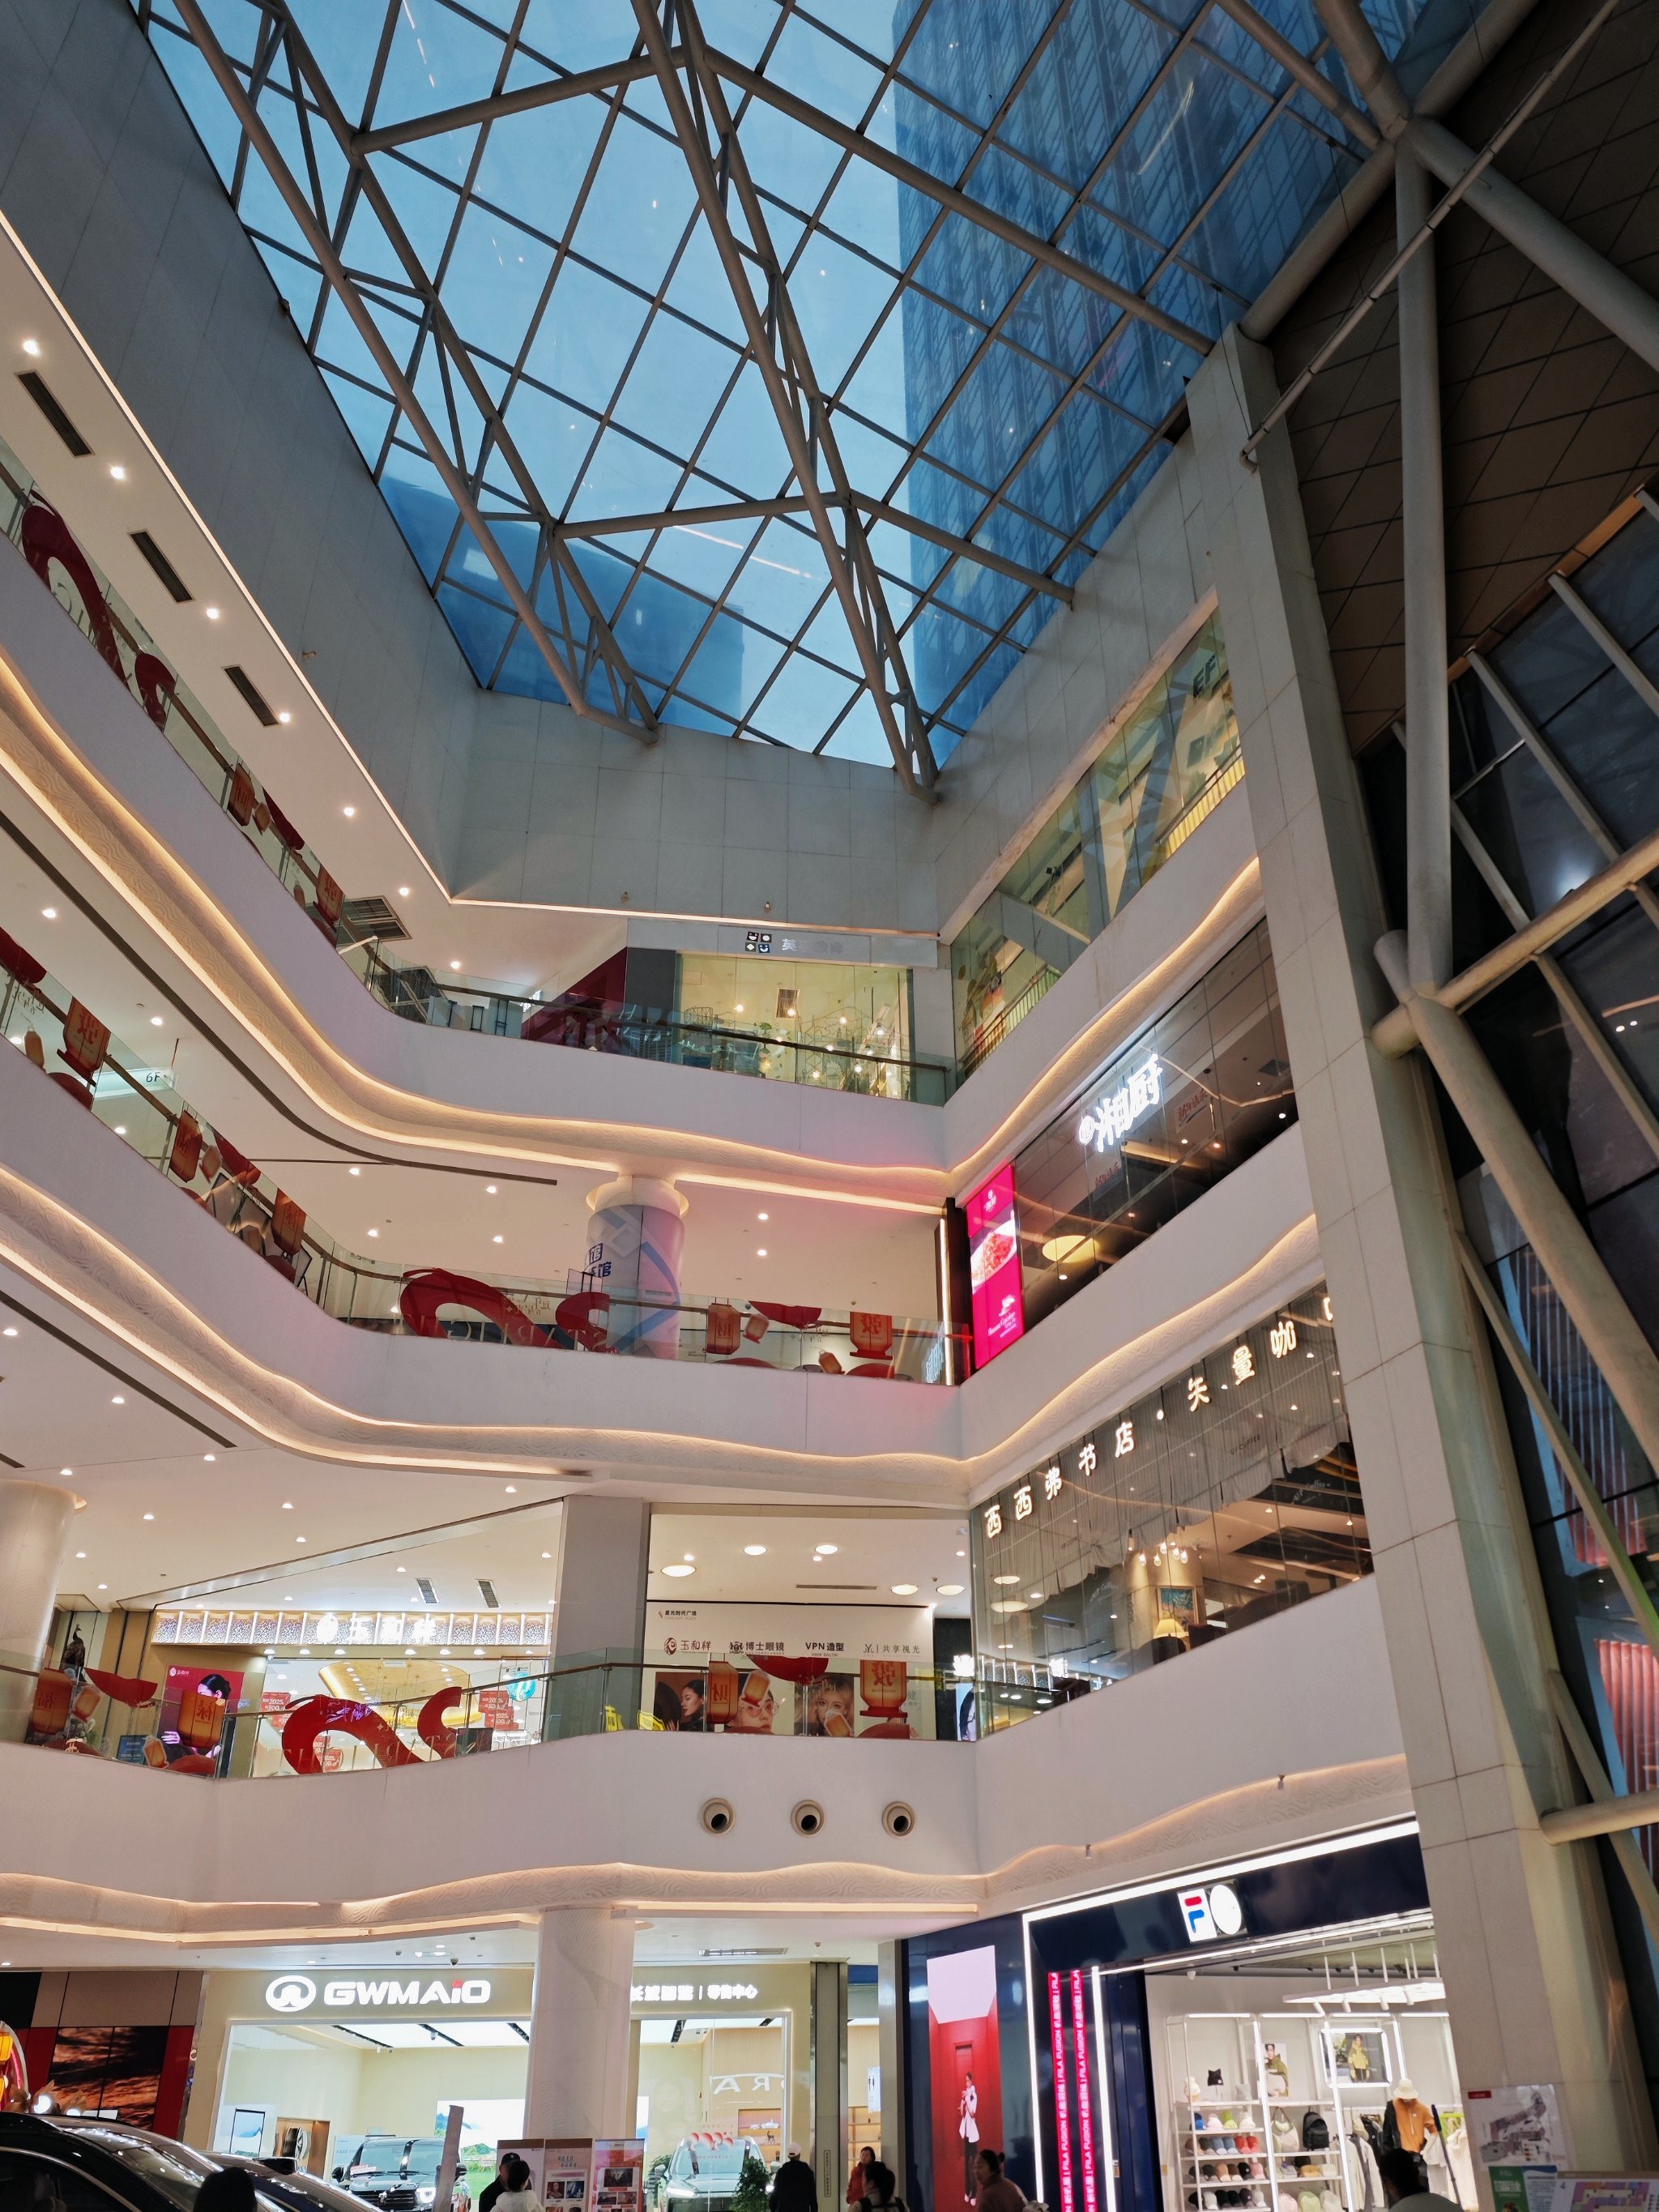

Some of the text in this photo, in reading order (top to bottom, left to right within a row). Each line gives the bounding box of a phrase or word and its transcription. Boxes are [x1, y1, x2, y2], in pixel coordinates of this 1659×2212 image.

[146, 1072, 161, 1083] 6F
[680, 1640, 711, 1650] 玉和祥
[745, 1642, 784, 1651] 博士眼镜
[805, 1642, 844, 1652] VPN 造型
[882, 1644, 920, 1654] 共享视光
